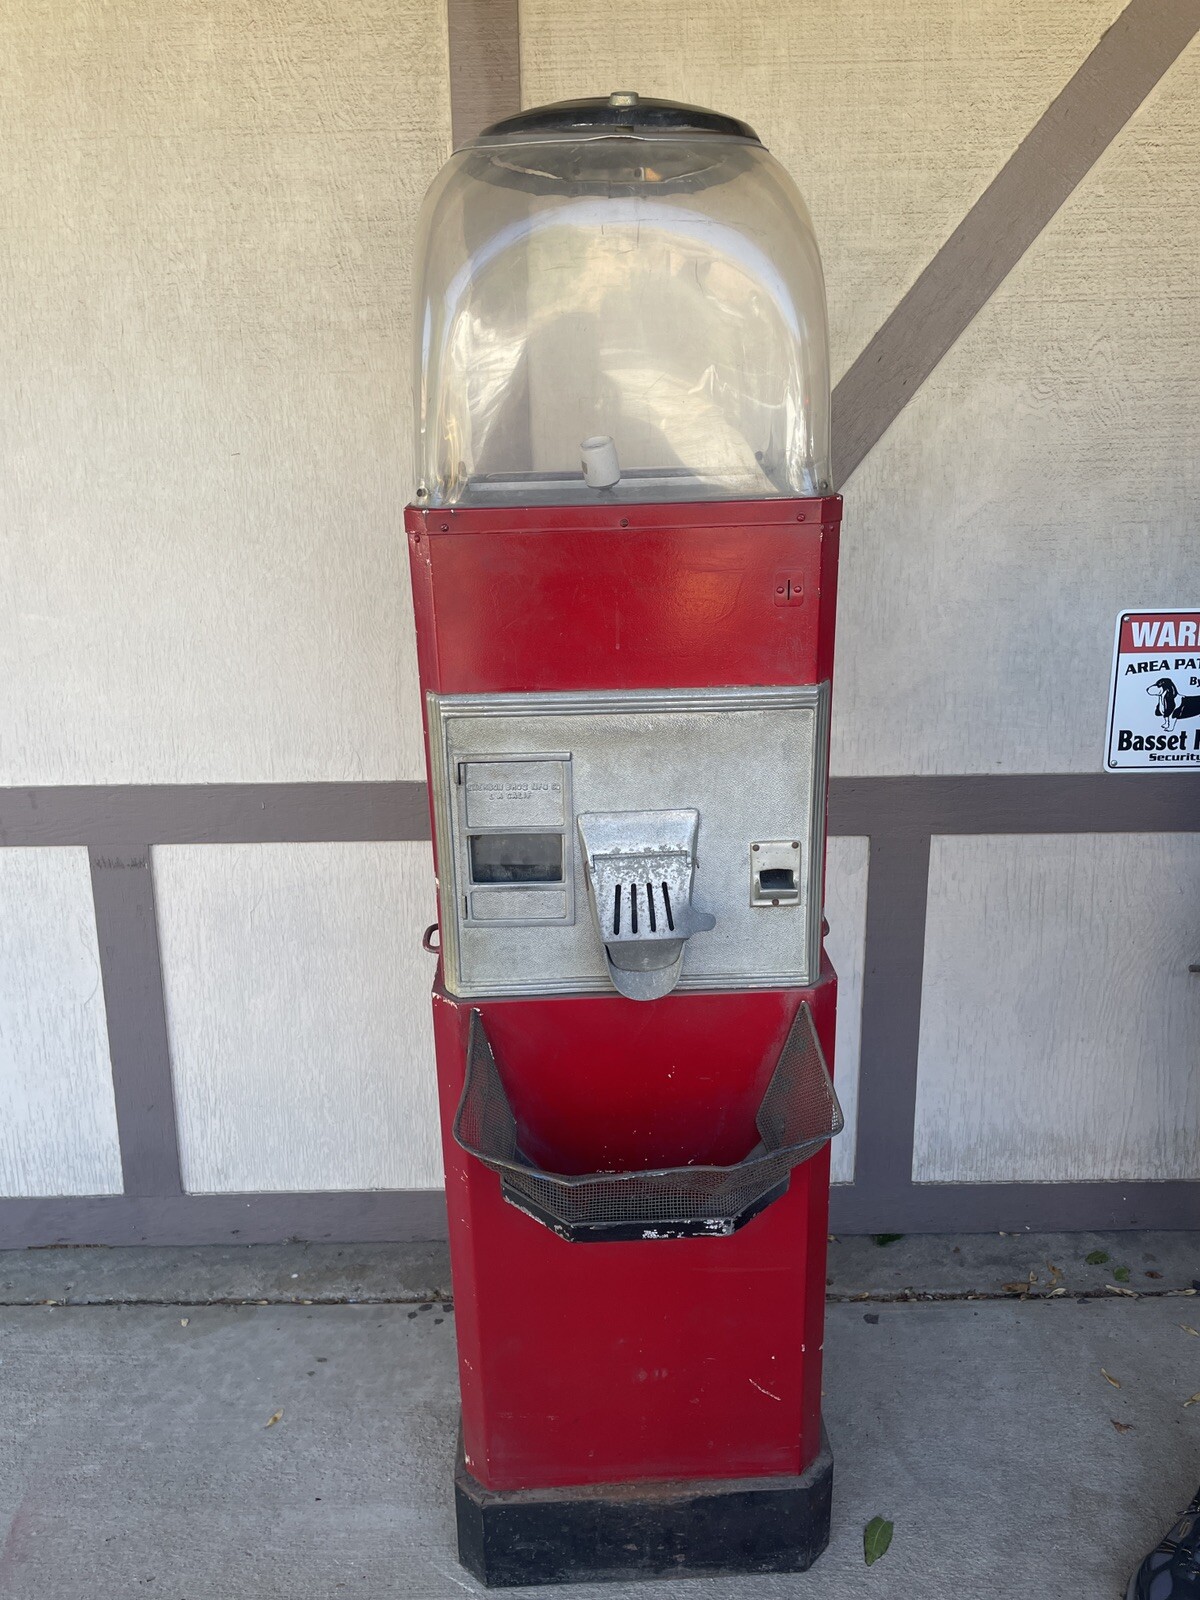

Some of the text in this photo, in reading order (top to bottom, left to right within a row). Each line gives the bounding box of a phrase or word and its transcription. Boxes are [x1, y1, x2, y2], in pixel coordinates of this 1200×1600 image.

[1131, 621, 1200, 647] WAR
[1125, 660, 1170, 676] AREA
[1117, 729, 1187, 751] Basset
